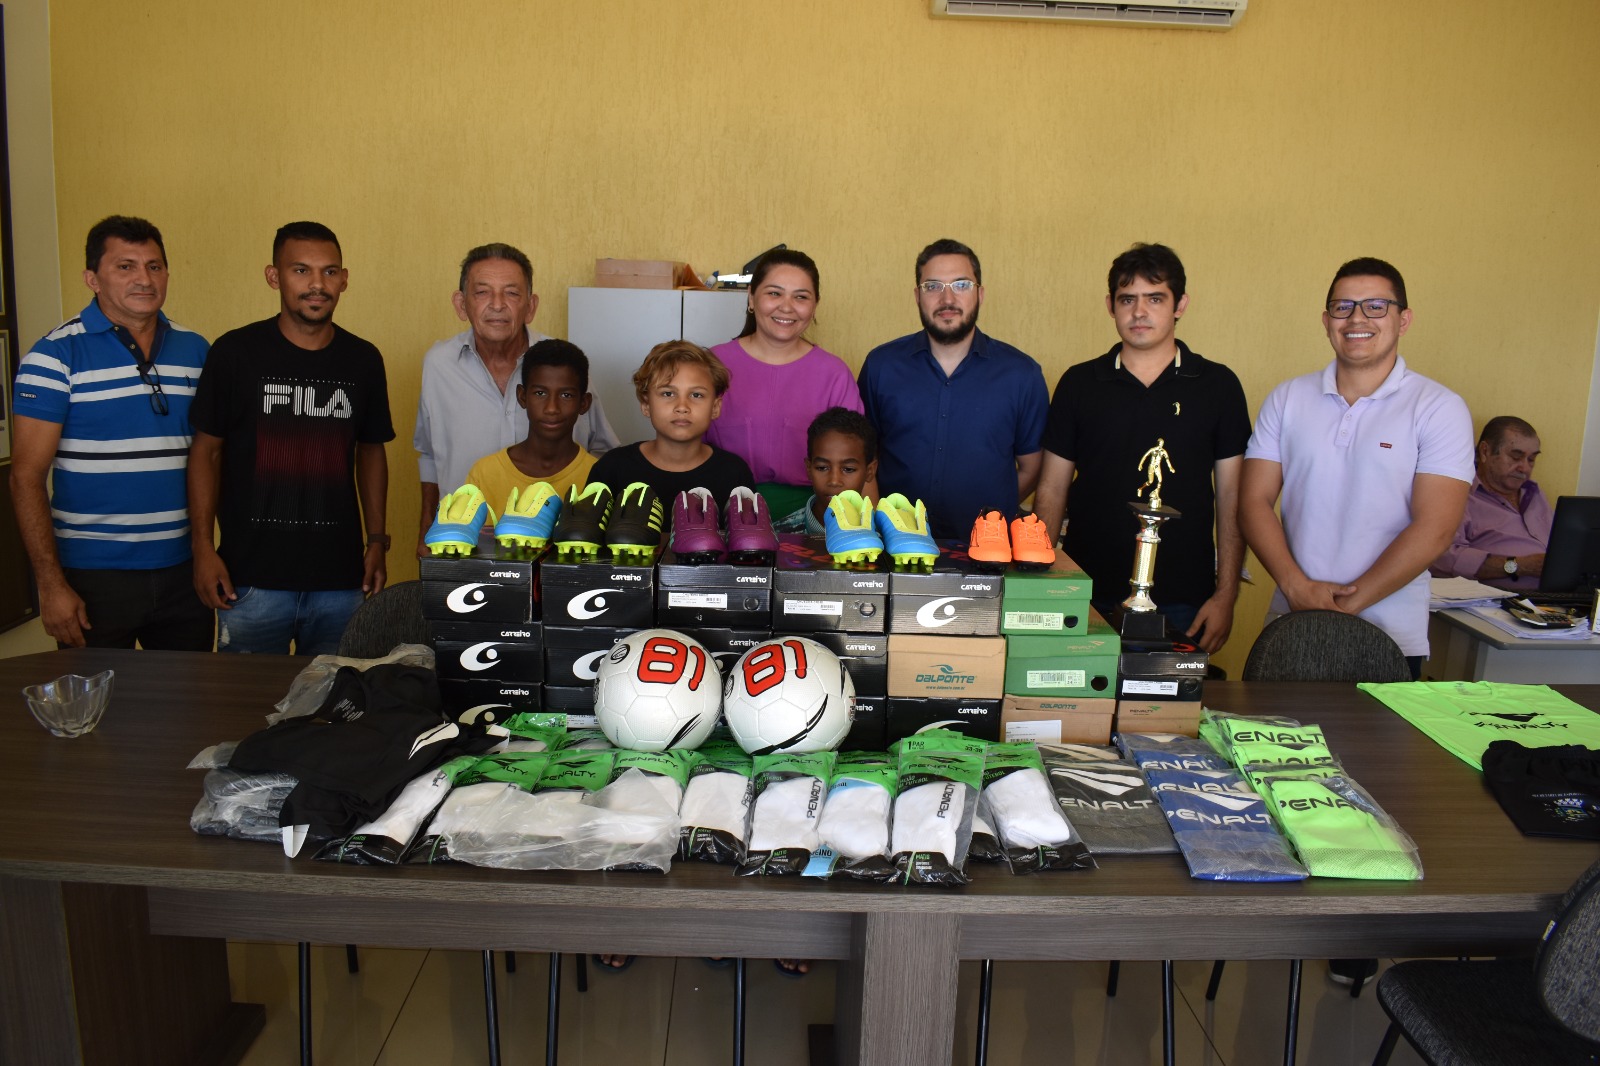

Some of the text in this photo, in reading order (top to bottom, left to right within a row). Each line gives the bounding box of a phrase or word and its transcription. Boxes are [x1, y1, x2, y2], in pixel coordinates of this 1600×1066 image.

[263, 383, 353, 419] FILA
[806, 776, 823, 819] PENALTY
[936, 782, 956, 819] PENALTY
